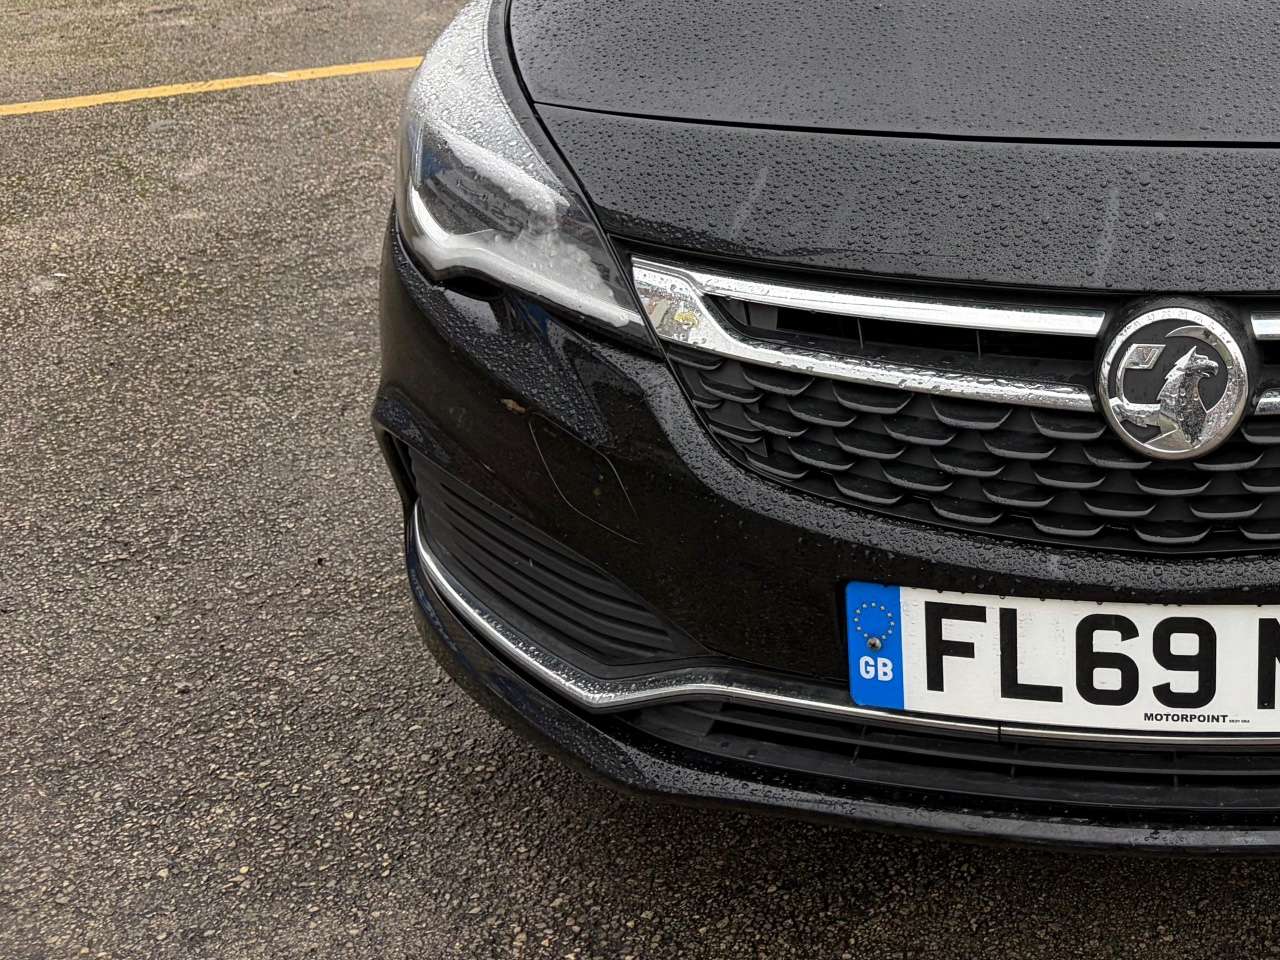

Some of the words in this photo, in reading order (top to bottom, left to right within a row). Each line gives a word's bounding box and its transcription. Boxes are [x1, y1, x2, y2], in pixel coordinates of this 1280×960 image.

[859, 655, 893, 683] GB
[924, 601, 1217, 709] FL69
[1144, 713, 1228, 723] MOTORPOINT
